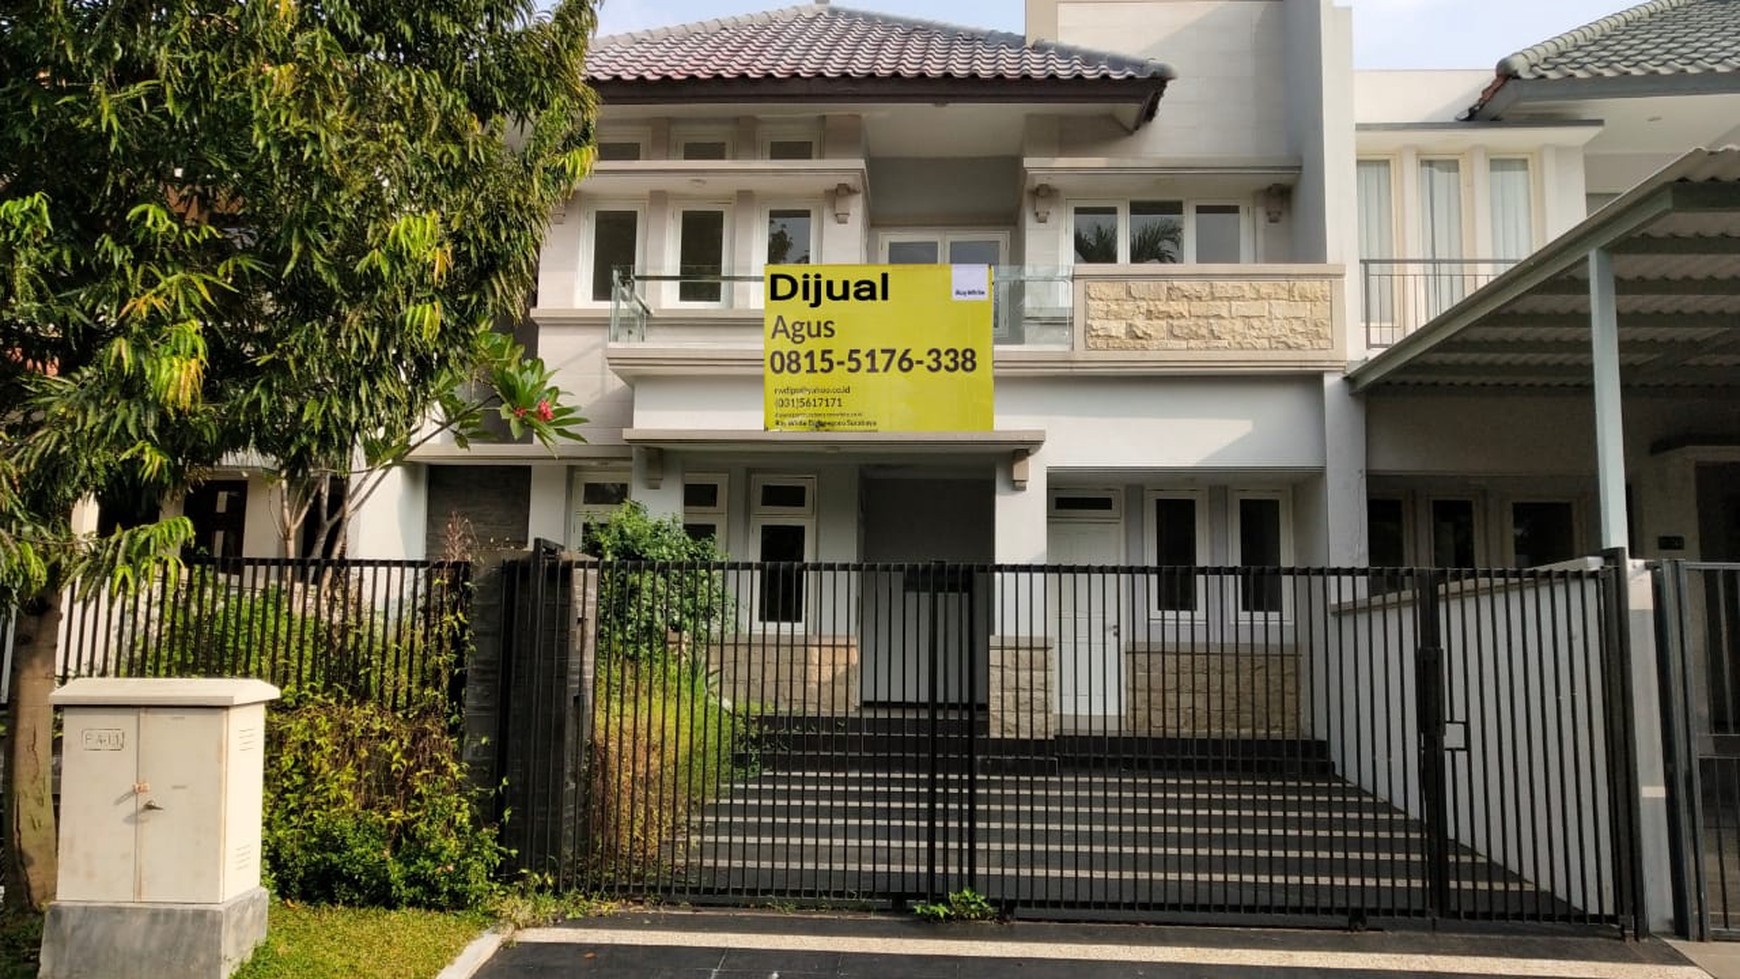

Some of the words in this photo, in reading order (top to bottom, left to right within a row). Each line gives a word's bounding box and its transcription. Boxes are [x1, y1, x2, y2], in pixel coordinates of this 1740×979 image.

[769, 272, 889, 308] Dijual
[771, 315, 836, 344] Agus
[769, 347, 978, 375] 0815-5176-338
[775, 397, 843, 409] (031)5617171
